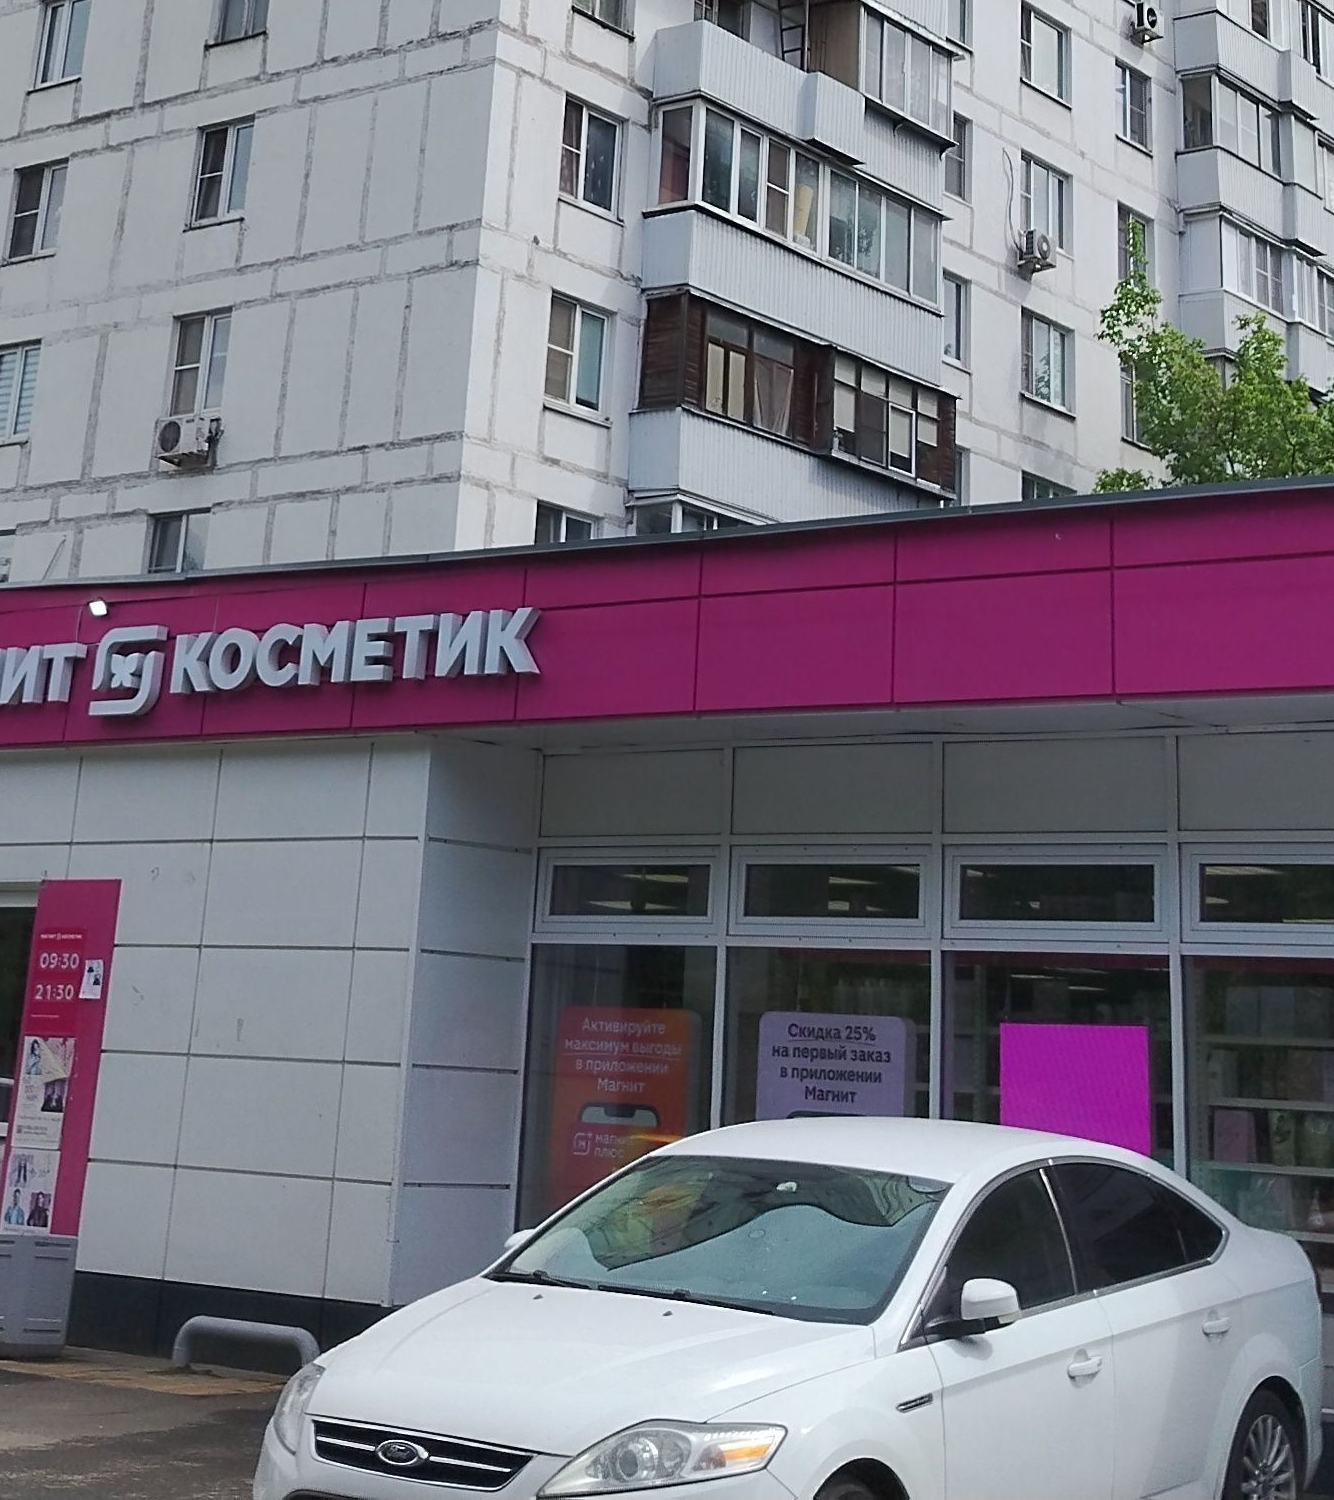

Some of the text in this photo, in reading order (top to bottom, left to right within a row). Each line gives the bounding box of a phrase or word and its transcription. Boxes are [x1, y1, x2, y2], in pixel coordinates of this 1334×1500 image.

[169, 607, 541, 695] КОСМЕТИК
[40, 953, 80, 969] 09:30
[35, 984, 75, 1000] 21:30
[582, 1017, 666, 1037] Активируйте
[787, 1023, 877, 1041] Скидка 25%
[564, 1038, 682, 1056] максимум выгоды
[772, 1044, 891, 1063] на первый заказ
[575, 1059, 669, 1074] в приложении
[779, 1066, 883, 1083] в приложении
[597, 1077, 645, 1093] Магнит
[804, 1085, 857, 1103] Магнит
